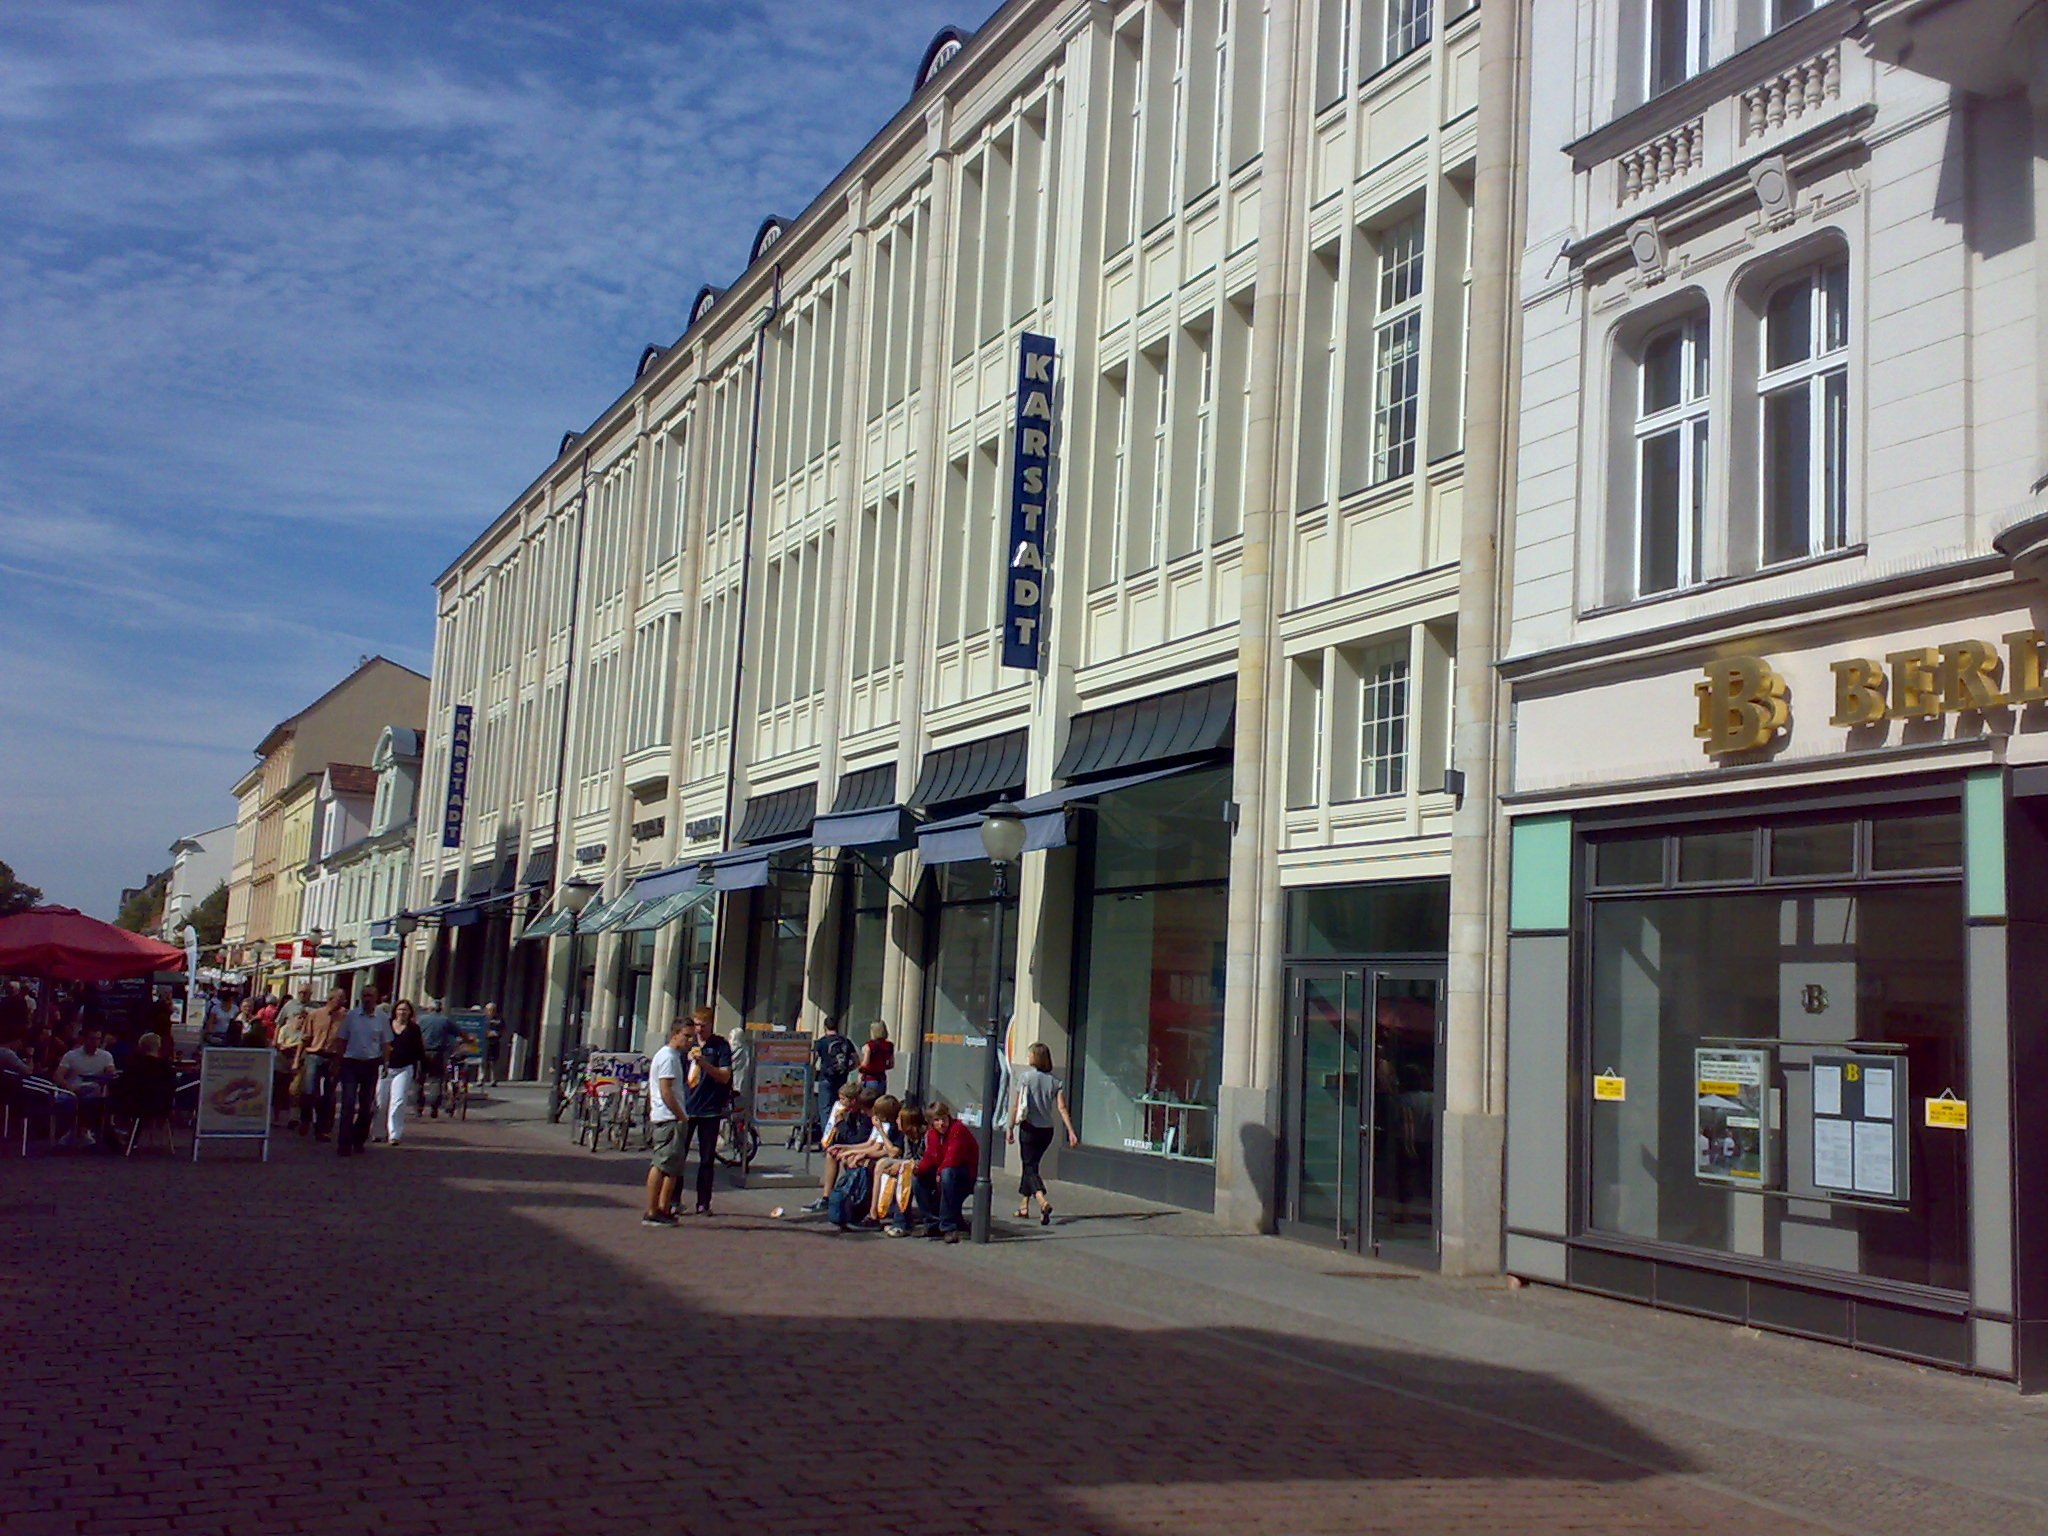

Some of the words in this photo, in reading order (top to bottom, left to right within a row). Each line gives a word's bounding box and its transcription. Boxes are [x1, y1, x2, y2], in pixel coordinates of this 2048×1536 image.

[1012, 352, 1053, 646] KARSTADT
[447, 713, 469, 838] KARSTADT
[1845, 1063, 1860, 1082] B
